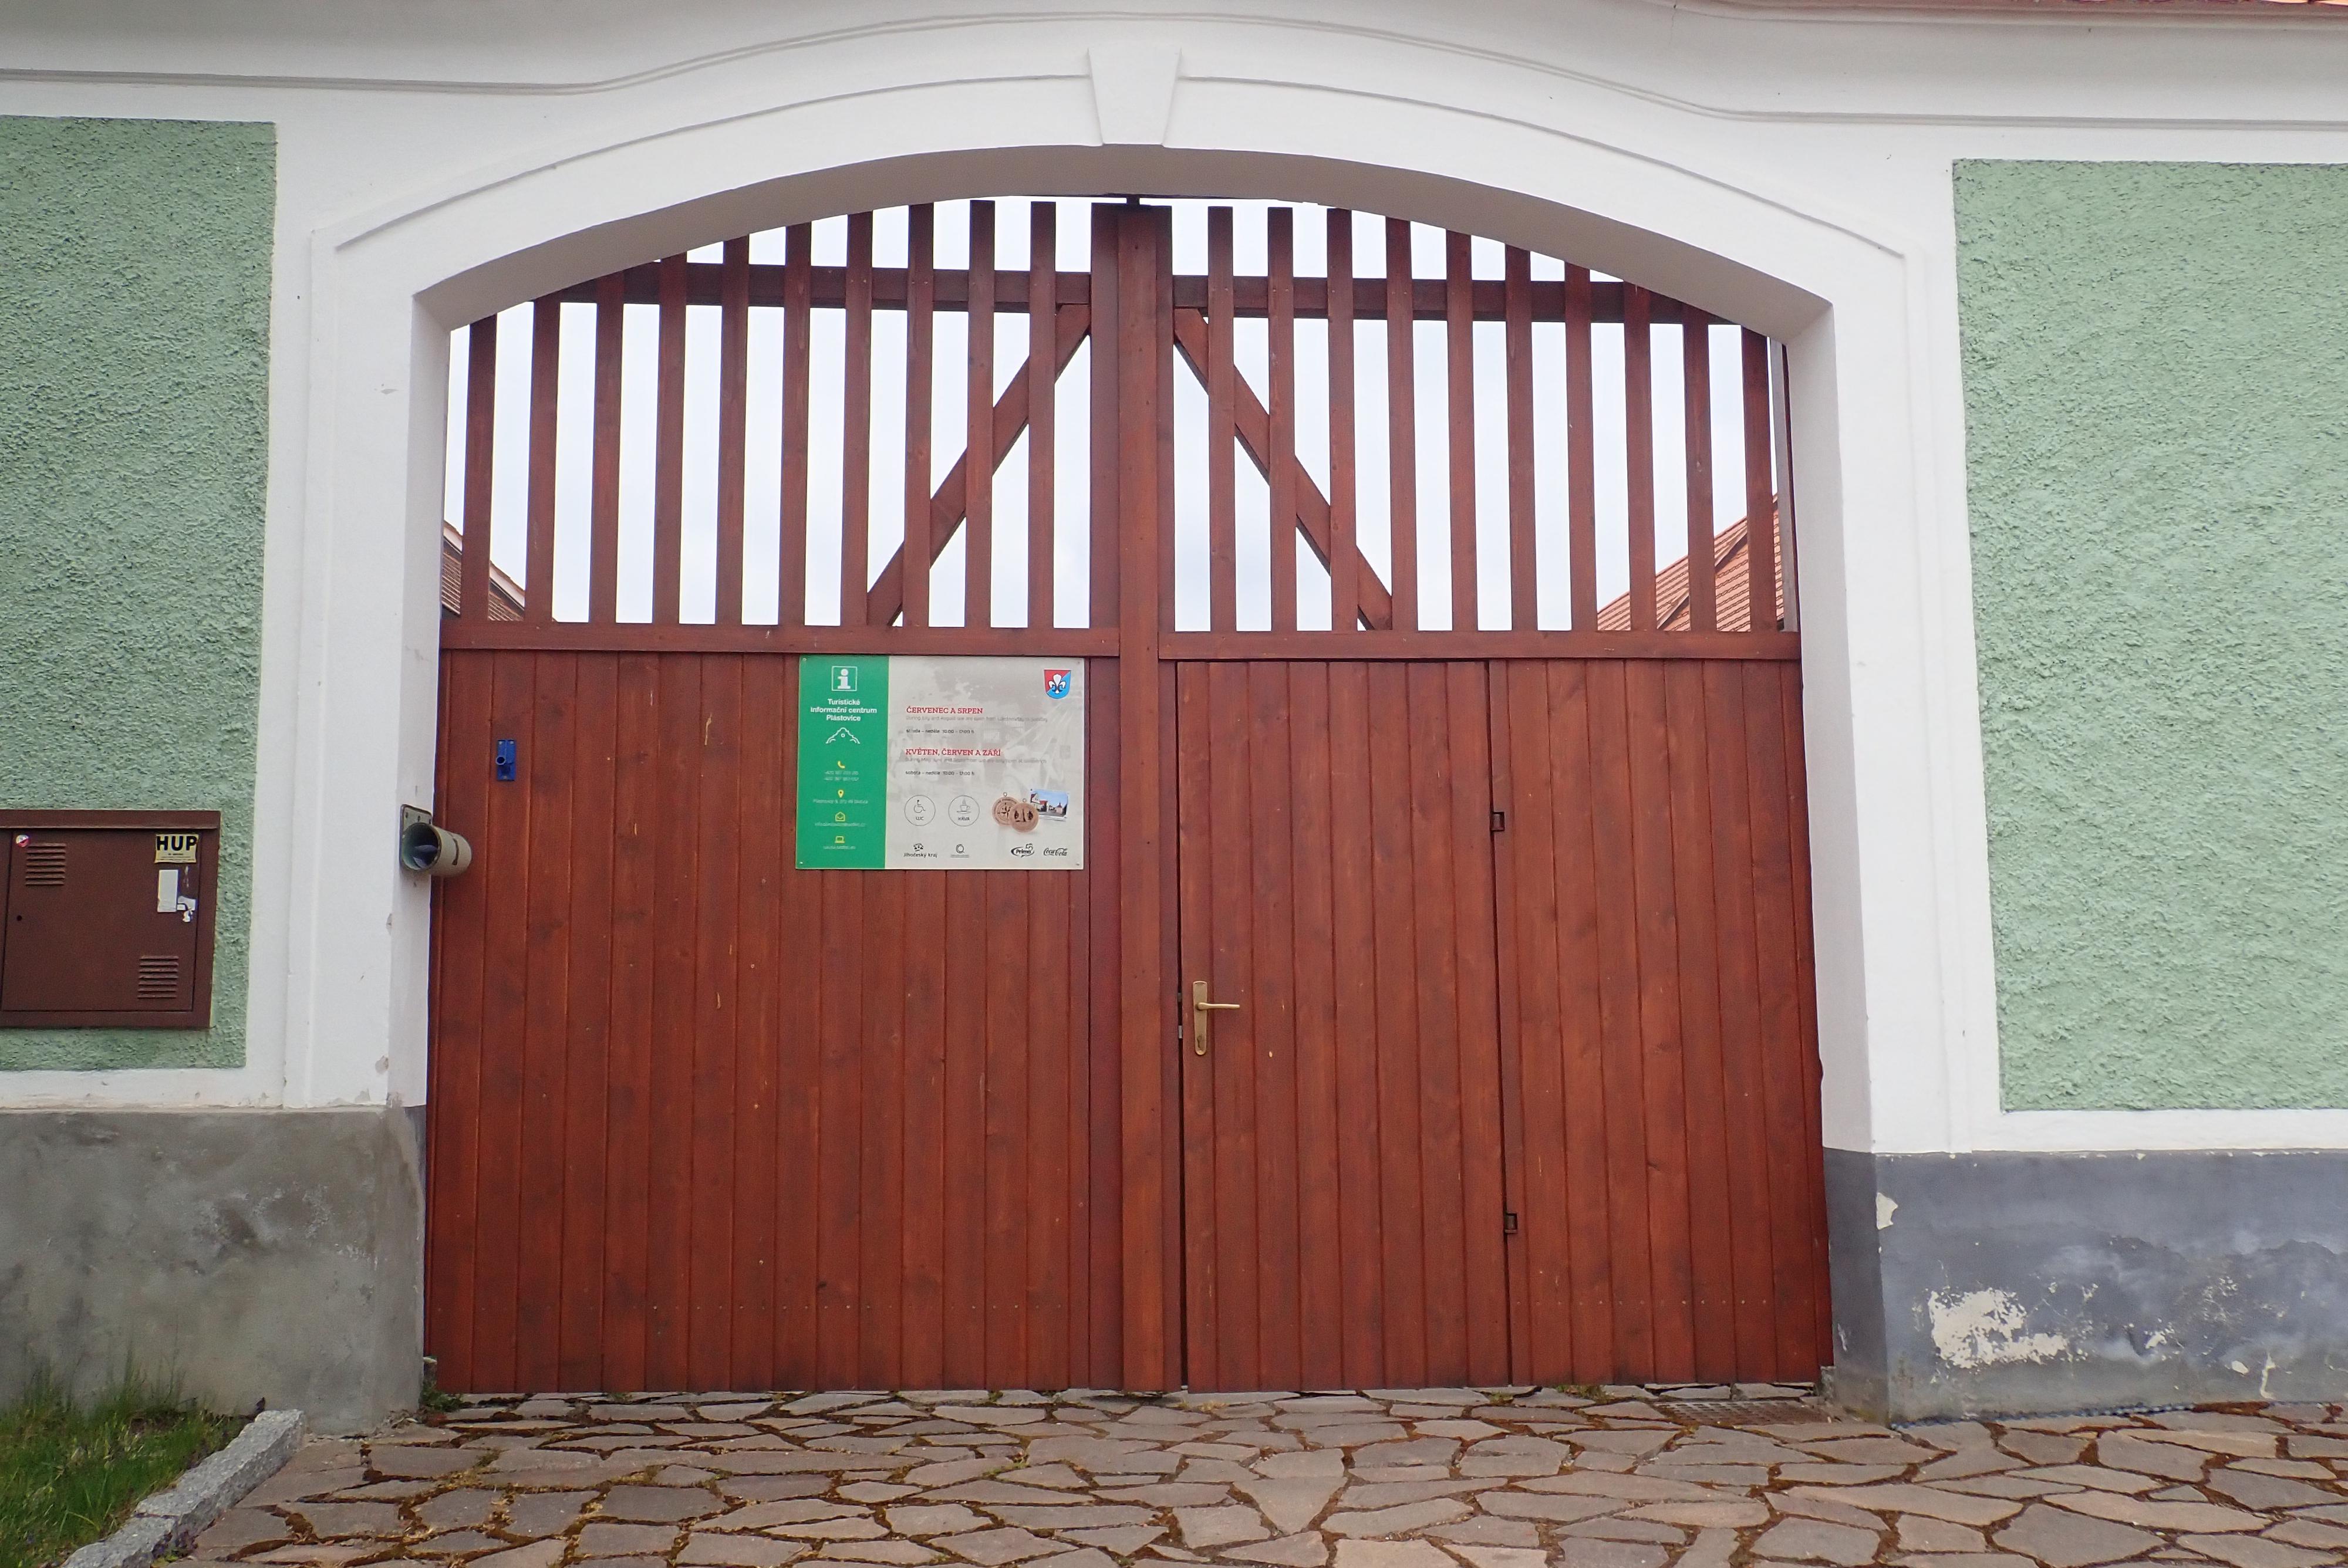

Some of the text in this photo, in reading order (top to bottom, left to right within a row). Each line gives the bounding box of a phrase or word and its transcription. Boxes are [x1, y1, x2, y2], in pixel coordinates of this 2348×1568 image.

[906, 748, 940, 756] KVĚTEN,
[983, 748, 1001, 756] ZÁŘÍ
[157, 836, 197, 851] HUP
